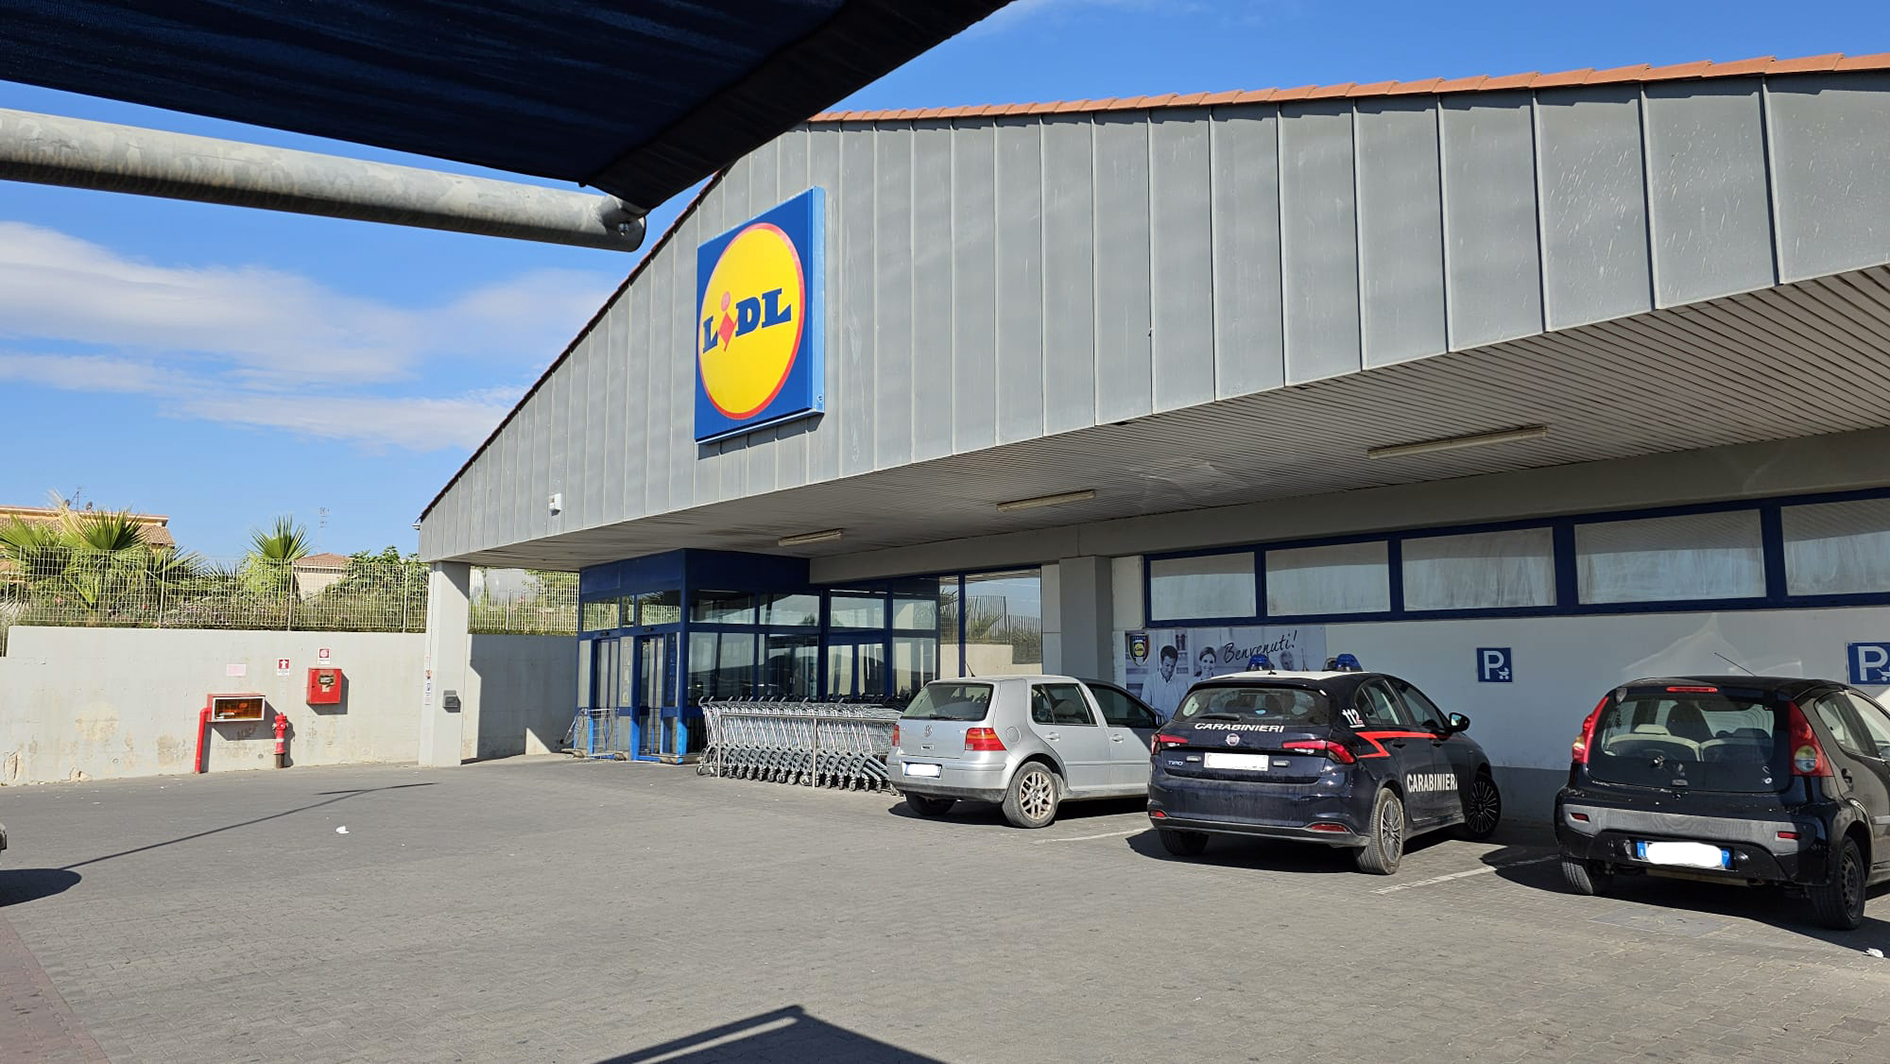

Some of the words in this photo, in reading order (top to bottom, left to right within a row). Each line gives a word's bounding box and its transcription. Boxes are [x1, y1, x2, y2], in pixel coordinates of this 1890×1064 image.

[703, 288, 791, 353] LIDL
[1223, 630, 1298, 663] Benvenuti!
[1483, 650, 1504, 679] P
[1858, 646, 1888, 681] P
[1194, 723, 1285, 733] CARABINIERI
[1342, 709, 1363, 726] 112
